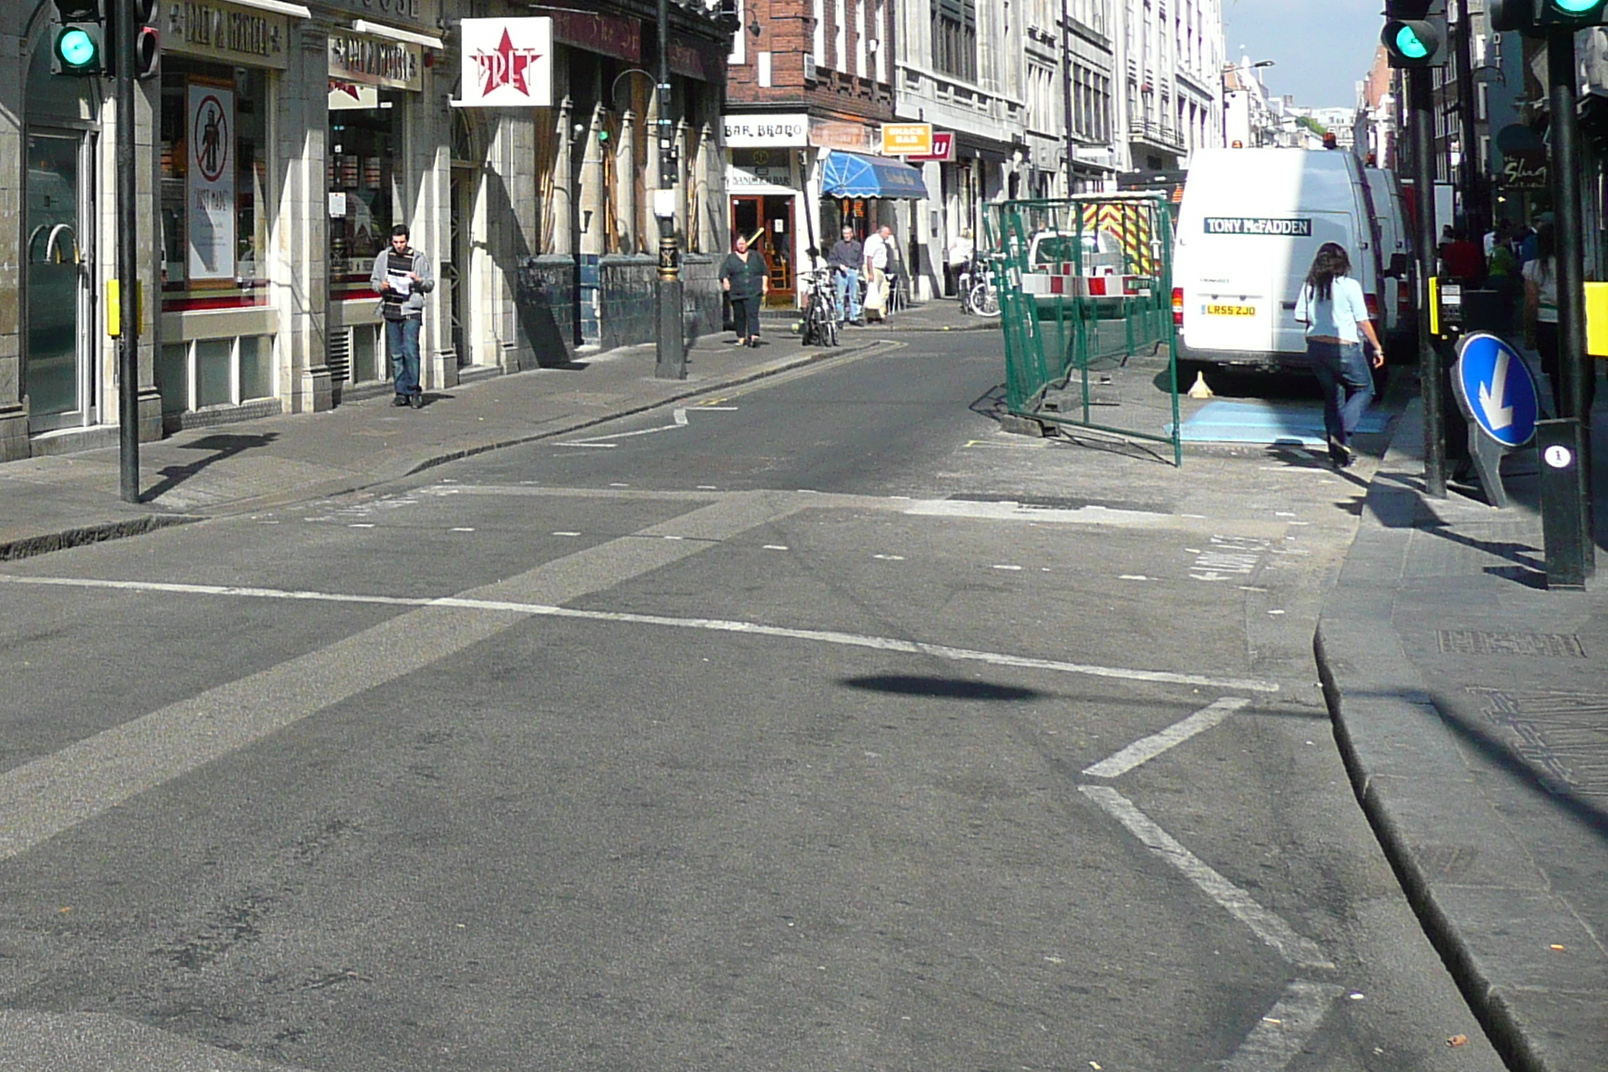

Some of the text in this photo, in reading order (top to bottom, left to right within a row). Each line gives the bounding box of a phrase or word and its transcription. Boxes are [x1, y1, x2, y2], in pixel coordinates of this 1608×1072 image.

[476, 47, 535, 88] PRET
[724, 124, 754, 137] BAR
[757, 123, 802, 138] BRUNO
[1206, 218, 1308, 235] TONY McFADDEN
